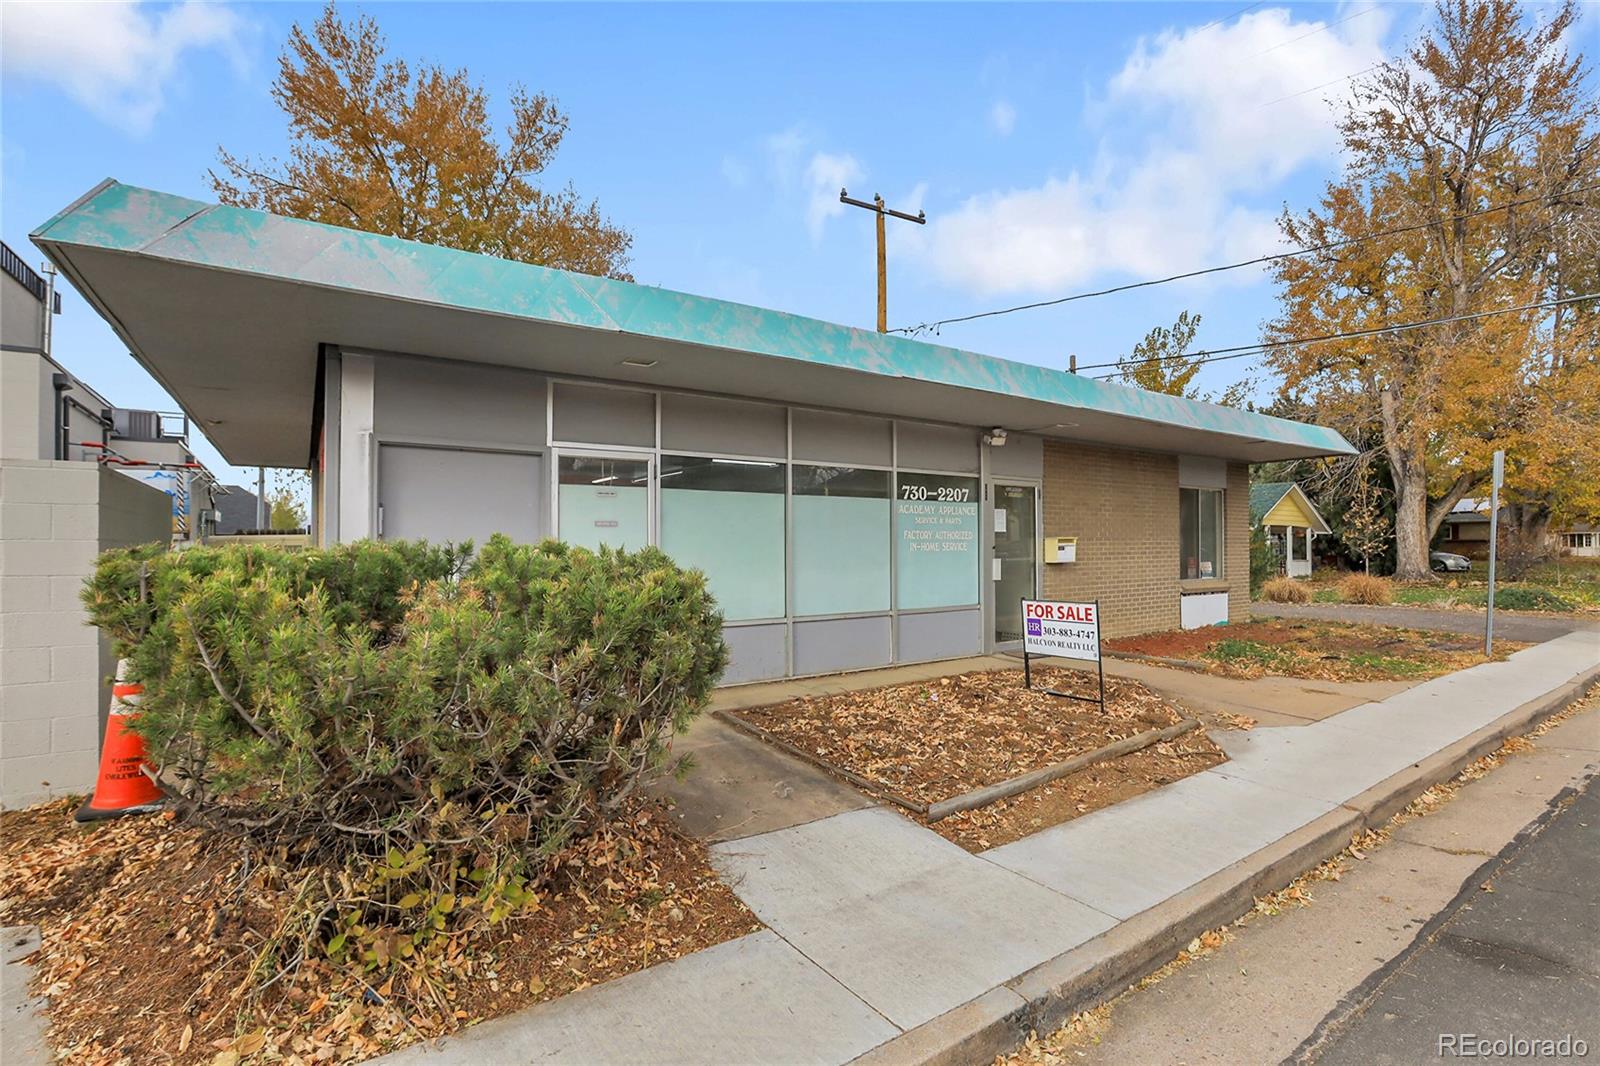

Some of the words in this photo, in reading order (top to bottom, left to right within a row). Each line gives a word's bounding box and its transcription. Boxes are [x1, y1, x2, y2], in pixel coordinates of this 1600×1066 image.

[901, 484, 969, 502] 730-2207
[898, 504, 935, 514] ACADEMY
[939, 505, 977, 515] APPLIANCE
[903, 530, 932, 540] FACTORY
[935, 531, 973, 540] AUTHORIZED
[909, 542, 940, 552] IN-HOME
[942, 542, 968, 552] SERVICE
[1026, 604, 1054, 618] FOR
[1057, 606, 1093, 621] SALE
[1028, 622, 1041, 631] HR
[1043, 627, 1095, 639] 303-883-4747
[1028, 638, 1056, 647] HALCYON
[1057, 641, 1081, 650] REALTY
